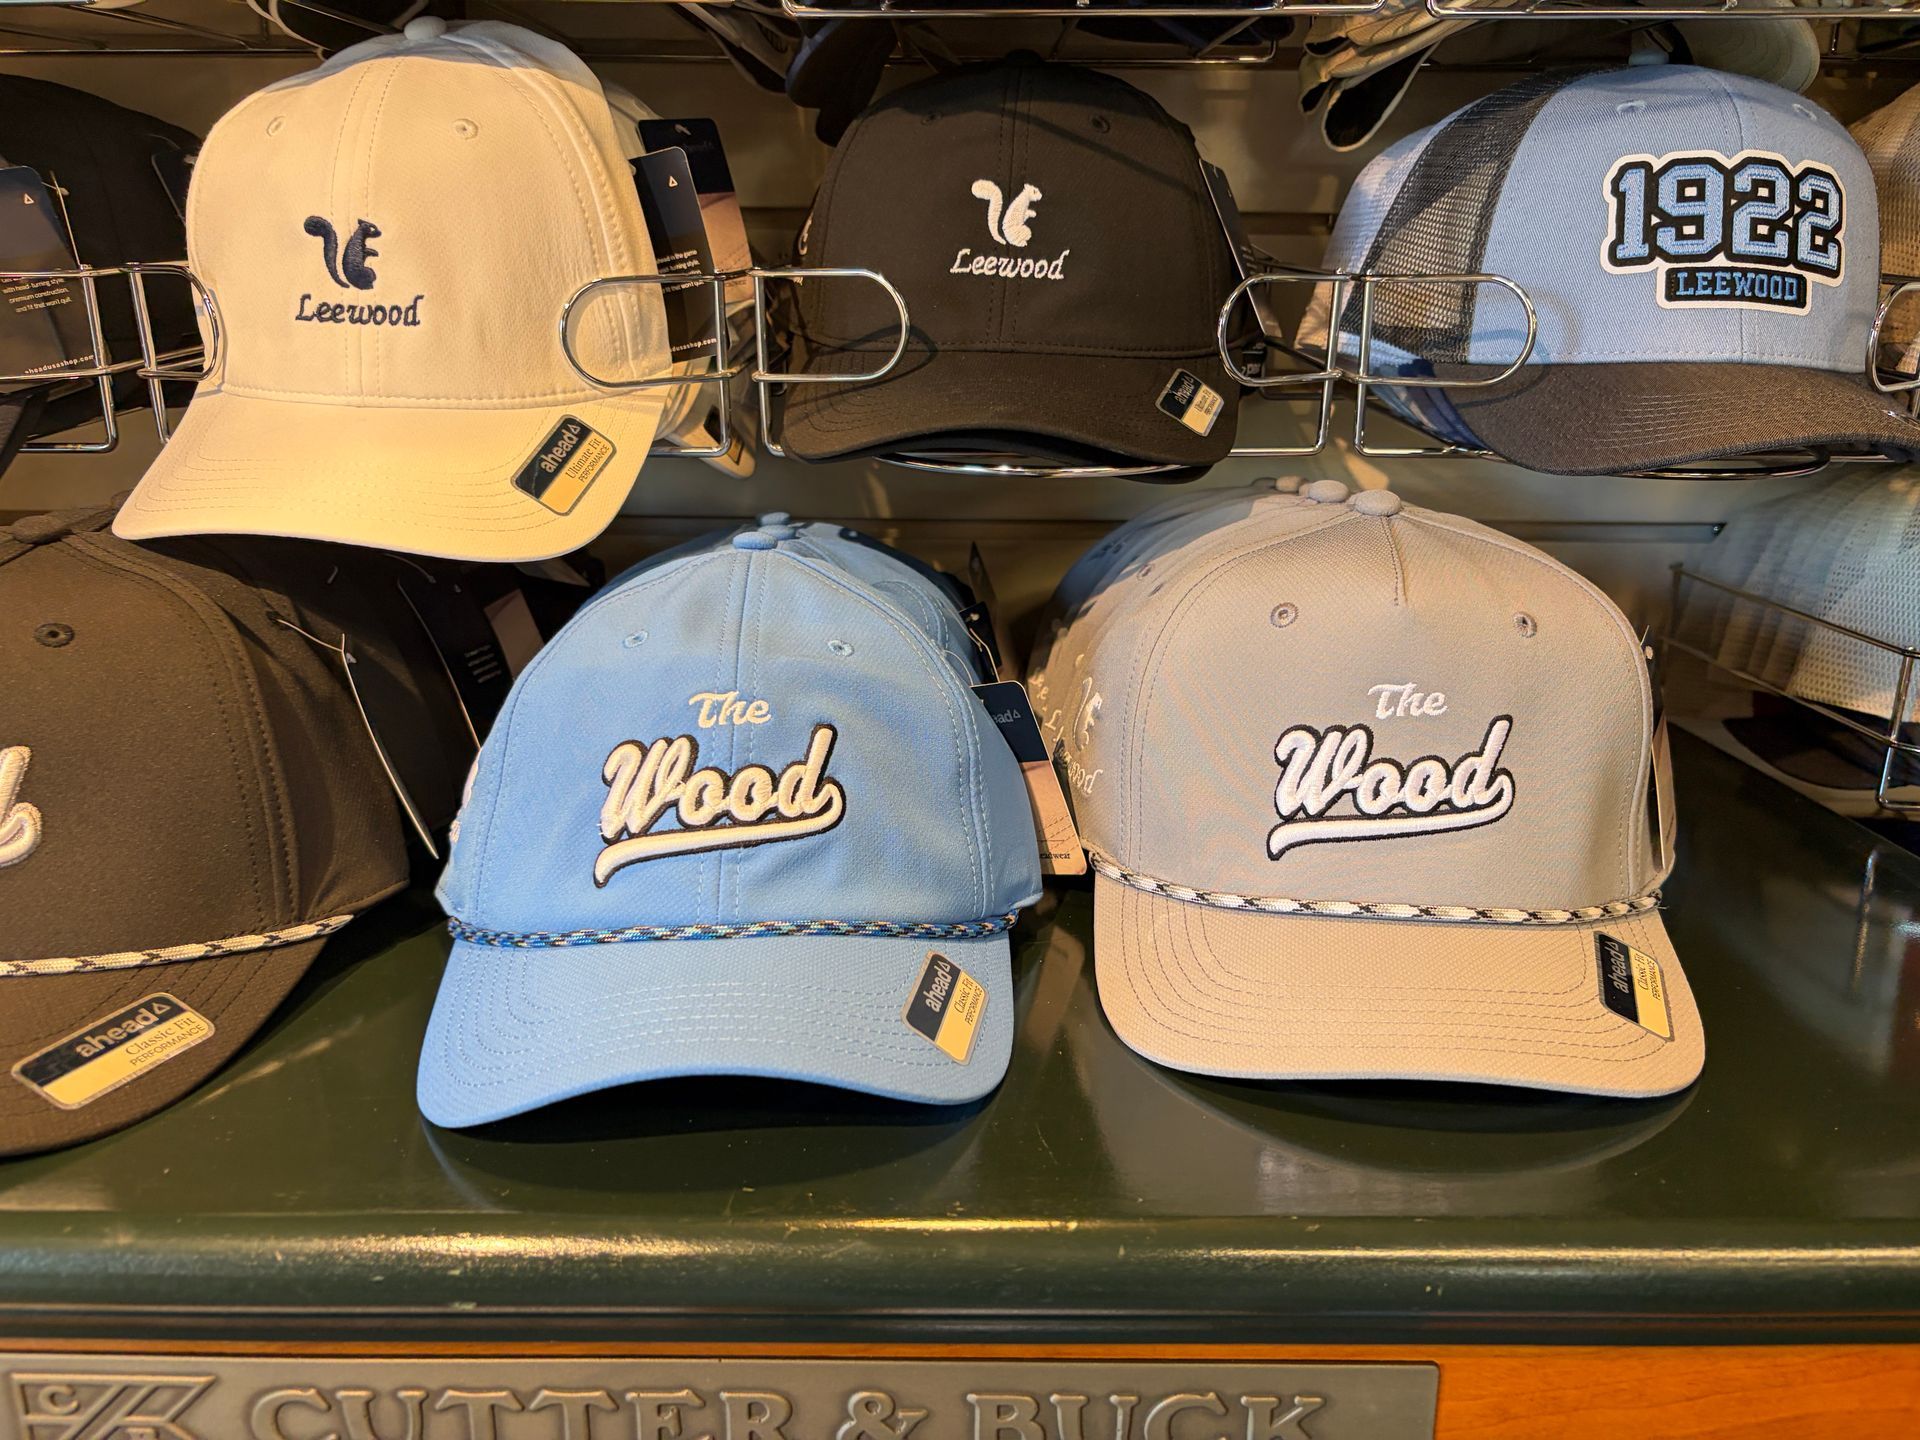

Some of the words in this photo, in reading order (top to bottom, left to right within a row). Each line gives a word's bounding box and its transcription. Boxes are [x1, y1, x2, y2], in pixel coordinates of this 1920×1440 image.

[1612, 160, 1842, 276] 1922
[950, 248, 1070, 280] Leewood
[1676, 271, 1798, 301] LEEWOOD
[295, 293, 424, 326] Leewood
[540, 429, 579, 473] ahead
[565, 447, 594, 479] Ultimate
[589, 438, 602, 451] Fit
[578, 445, 610, 483] PERFORMANCE
[688, 690, 772, 728] The
[1368, 682, 1448, 719] The
[597, 724, 846, 866] Wood
[1270, 714, 1515, 845] Wood
[1039, 851, 1071, 861] eadwear
[923, 965, 953, 1013] ahead
[962, 978, 975, 990] Fit
[1604, 946, 1629, 994] ahead
[954, 988, 971, 1014] Classic
[964, 986, 984, 1026] PERFORMANCE
[75, 1008, 159, 1058] ahead
[125, 1028, 176, 1056] Classic
[178, 1016, 196, 1030] Fit
[130, 1024, 206, 1066] PERFORMANCE
[252, 1388, 793, 1440] CUTTER
[836, 1391, 929, 1440] &
[966, 1391, 1326, 1440] BUCK
